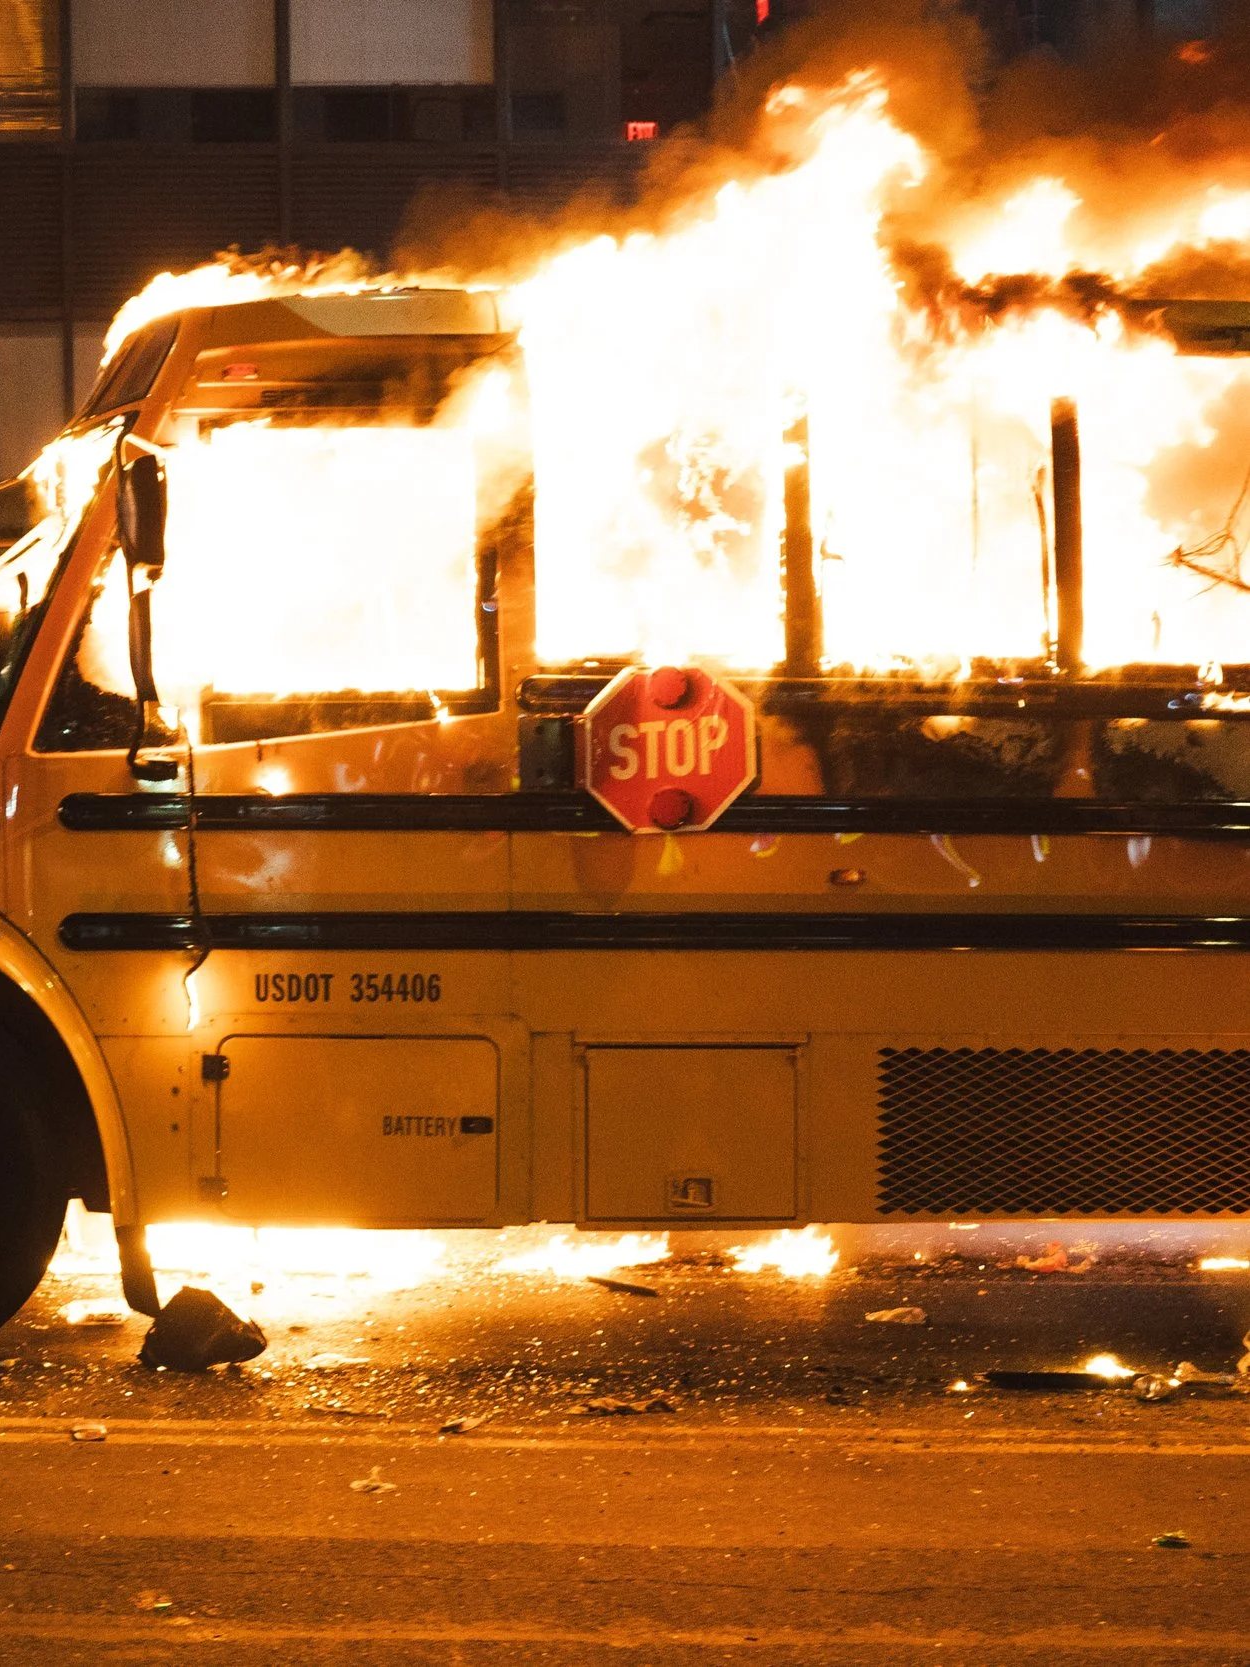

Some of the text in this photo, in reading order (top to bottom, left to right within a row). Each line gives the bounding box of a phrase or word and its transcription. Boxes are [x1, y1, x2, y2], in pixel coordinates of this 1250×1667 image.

[608, 714, 729, 781] STOP
[255, 972, 442, 1002] USDOT 354406
[383, 1115, 458, 1137] BATTERY
